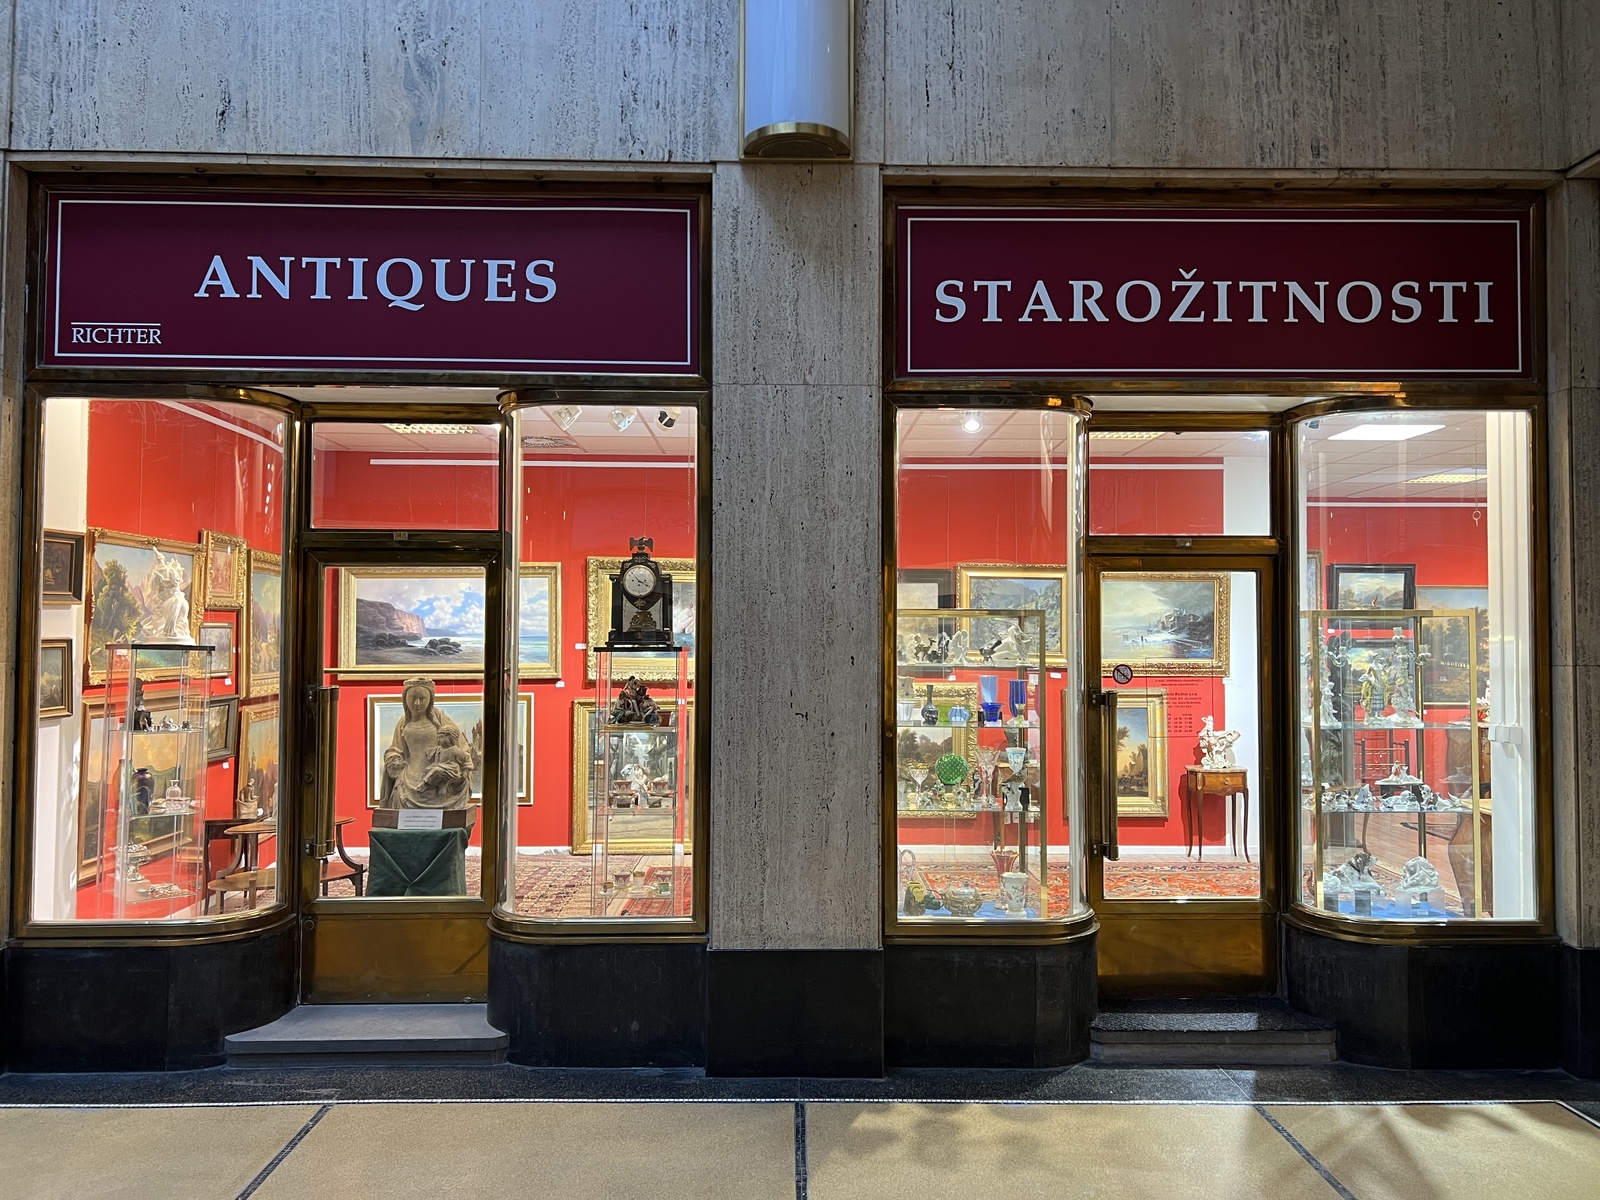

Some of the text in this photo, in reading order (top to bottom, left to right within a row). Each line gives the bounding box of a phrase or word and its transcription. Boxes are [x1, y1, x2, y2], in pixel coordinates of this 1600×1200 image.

[193, 254, 557, 311] ANTIQUES
[935, 268, 1494, 323] STAROŽITNOSTI
[71, 327, 162, 344] RICHTER
